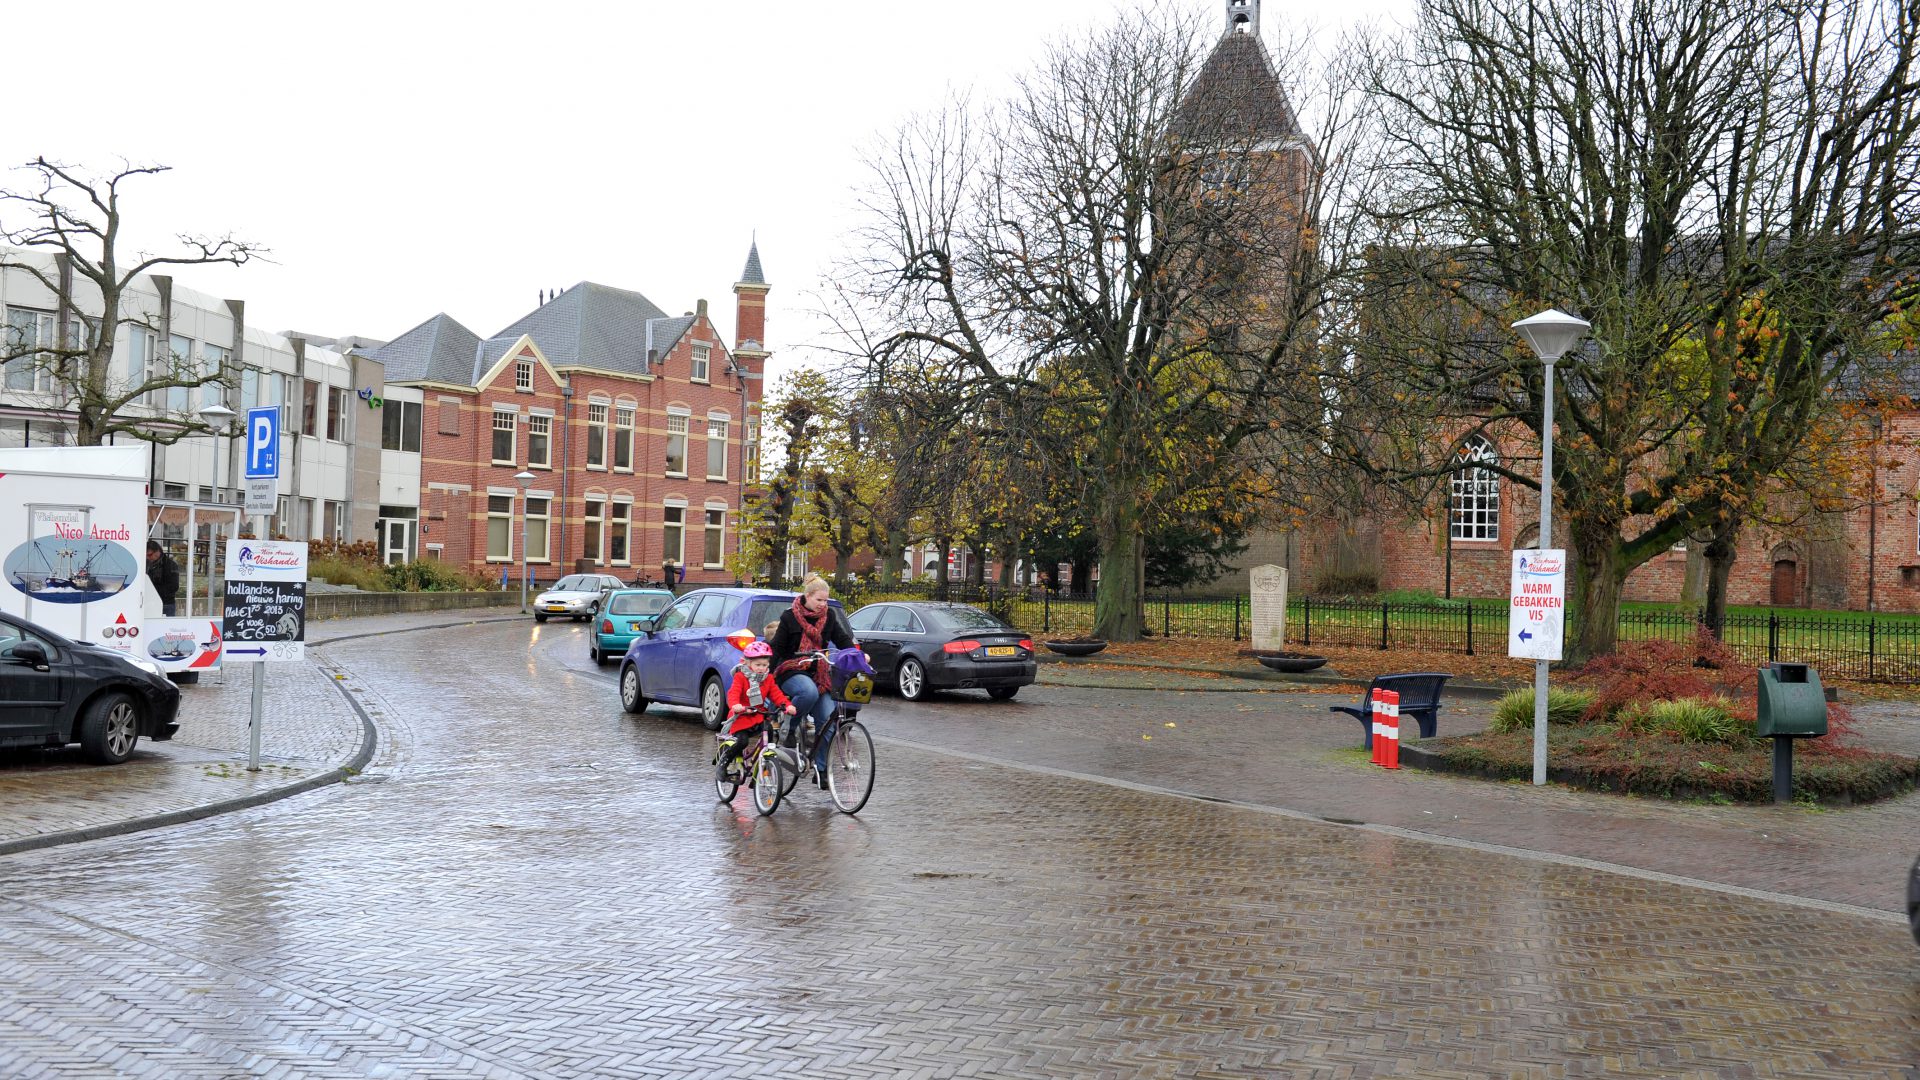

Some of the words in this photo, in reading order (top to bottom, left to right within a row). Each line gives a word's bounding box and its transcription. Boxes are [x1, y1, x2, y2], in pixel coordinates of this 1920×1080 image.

[252, 416, 272, 469] P
[54, 522, 83, 540] Nico
[89, 523, 130, 540] Arends
[253, 555, 299, 566] Vishandel
[1528, 563, 1561, 573] Vishandel
[227, 581, 274, 595] hollandse
[1522, 584, 1551, 594] WARM
[245, 594, 275, 604] nieuwe
[275, 587, 304, 610] haring
[1513, 596, 1561, 608] GEBAKKEN
[263, 605, 283, 614] 2013
[1529, 610, 1543, 621] VIS
[236, 619, 245, 630] 4
